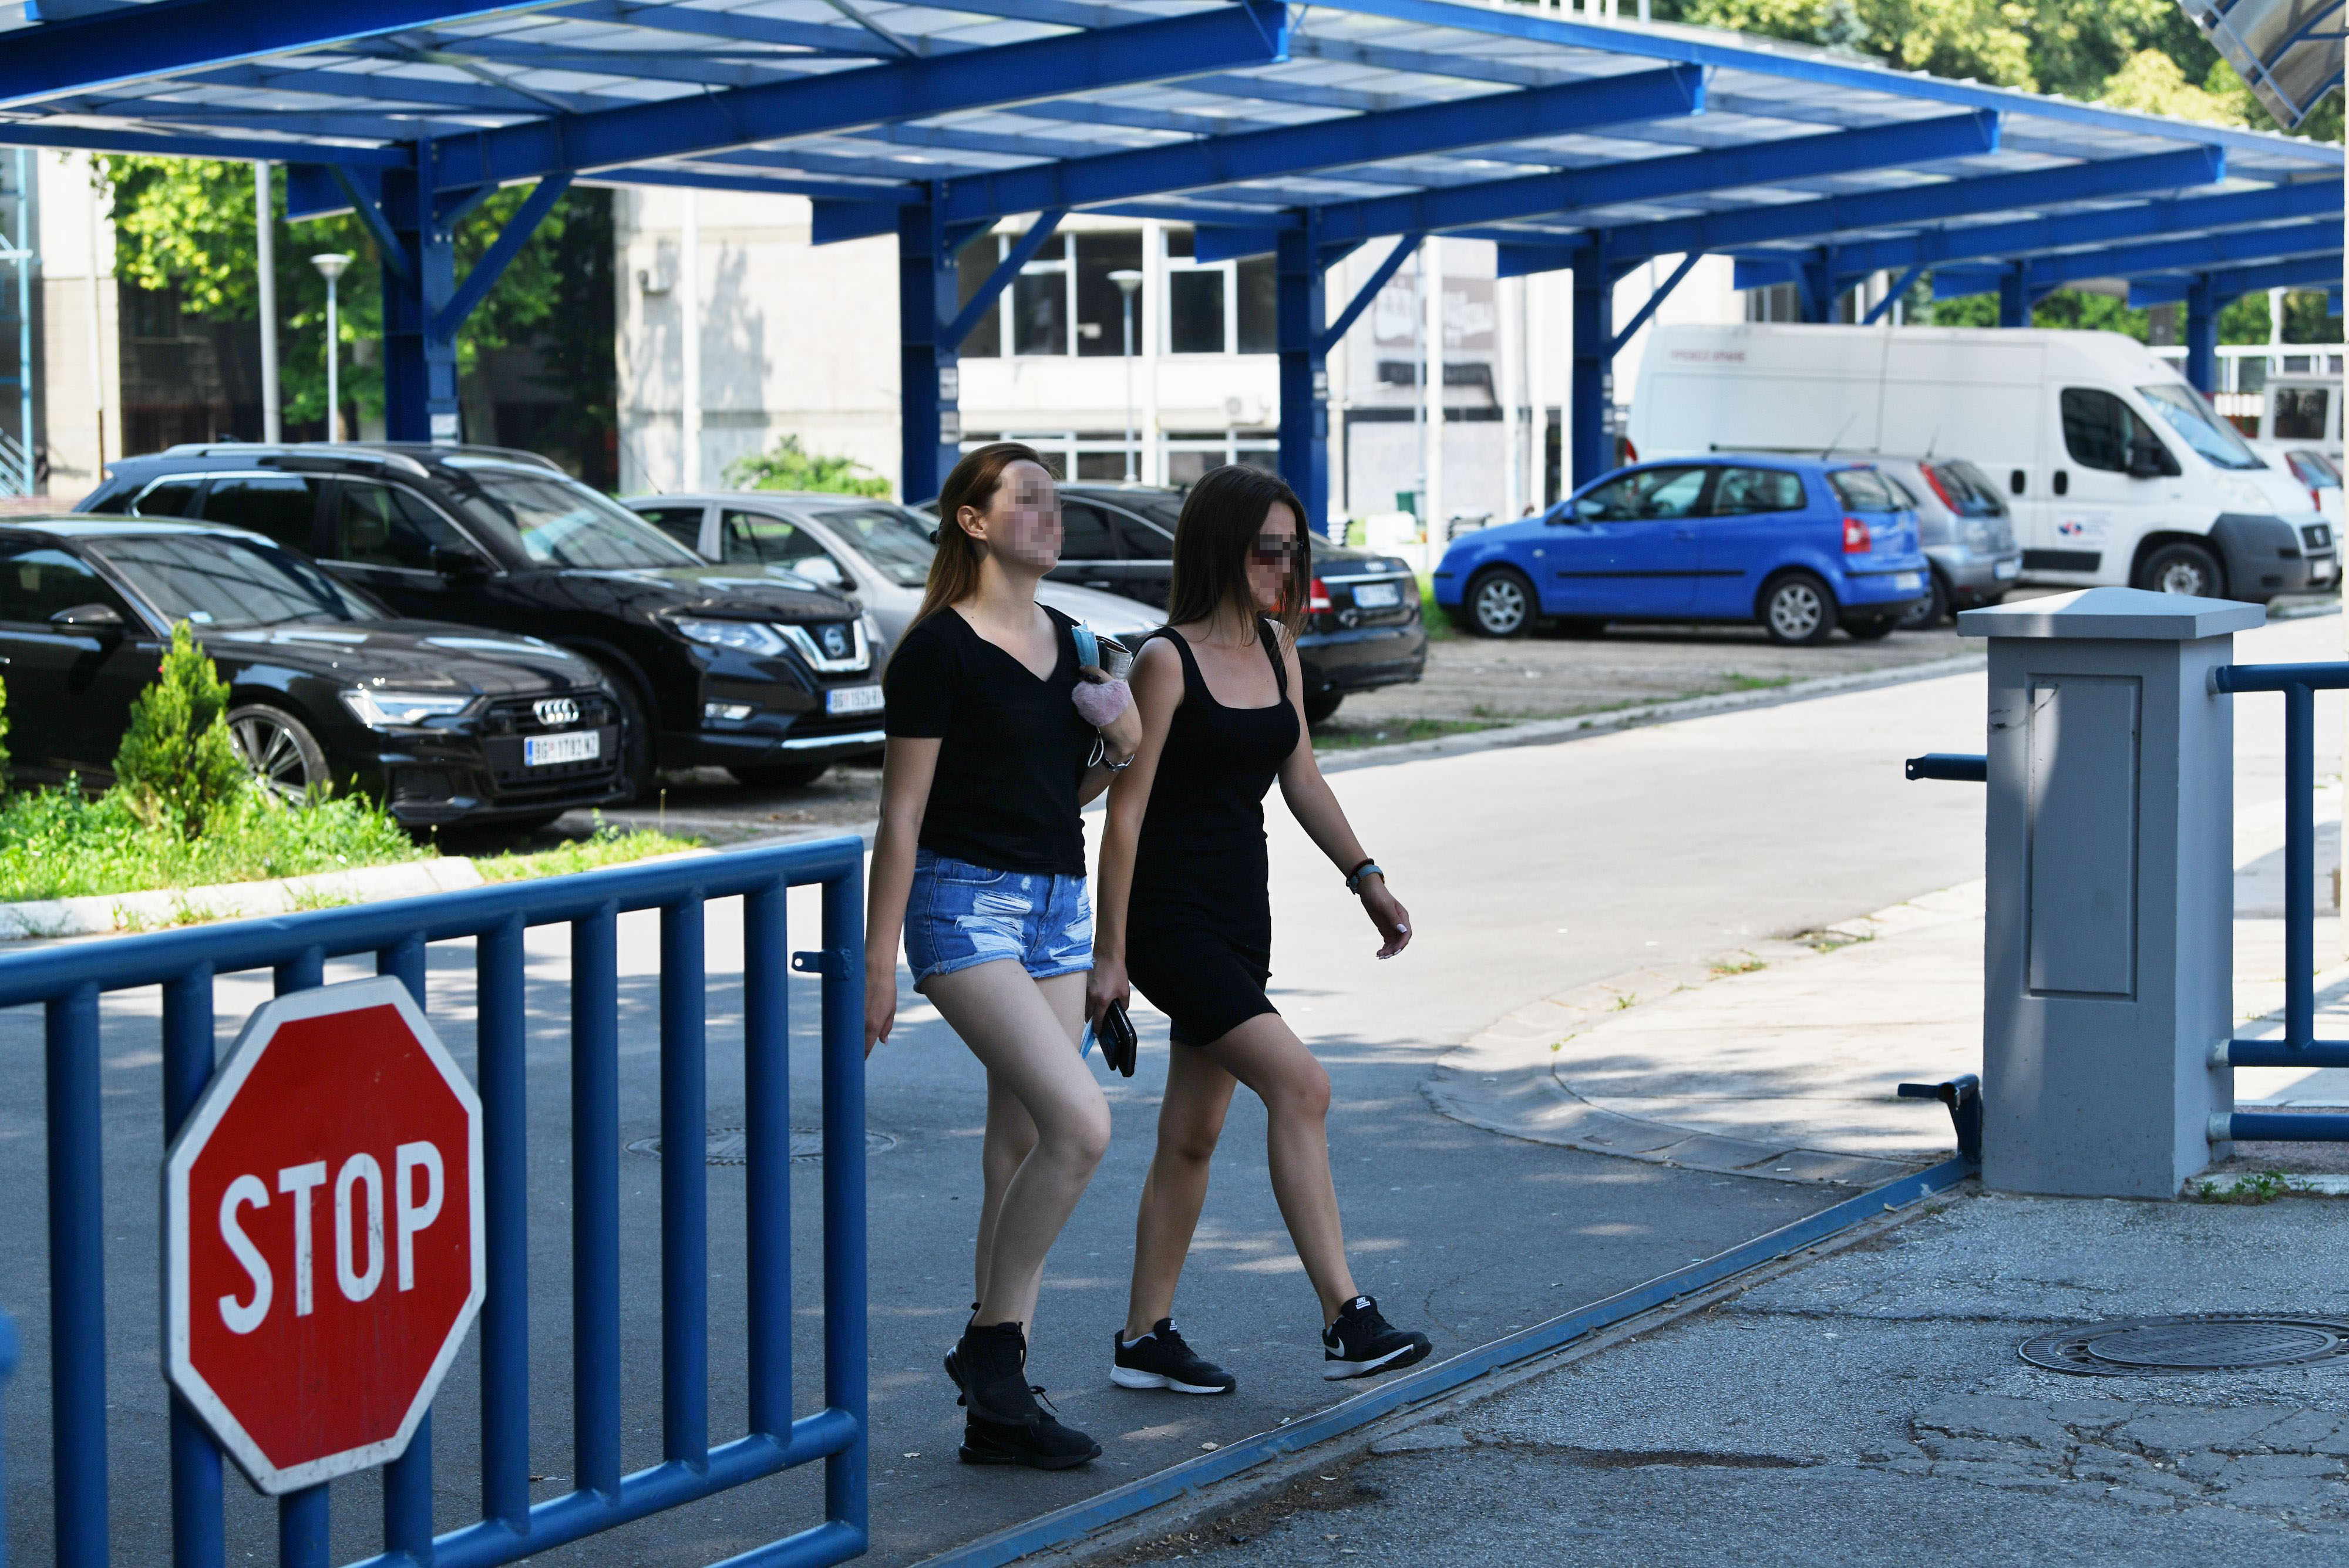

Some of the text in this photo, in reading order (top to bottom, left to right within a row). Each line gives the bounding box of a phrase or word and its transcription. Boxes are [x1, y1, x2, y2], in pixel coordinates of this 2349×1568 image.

[535, 742, 548, 760] BG
[218, 1140, 445, 1334] STOP
[1357, 1296, 1367, 1305] NIKE
